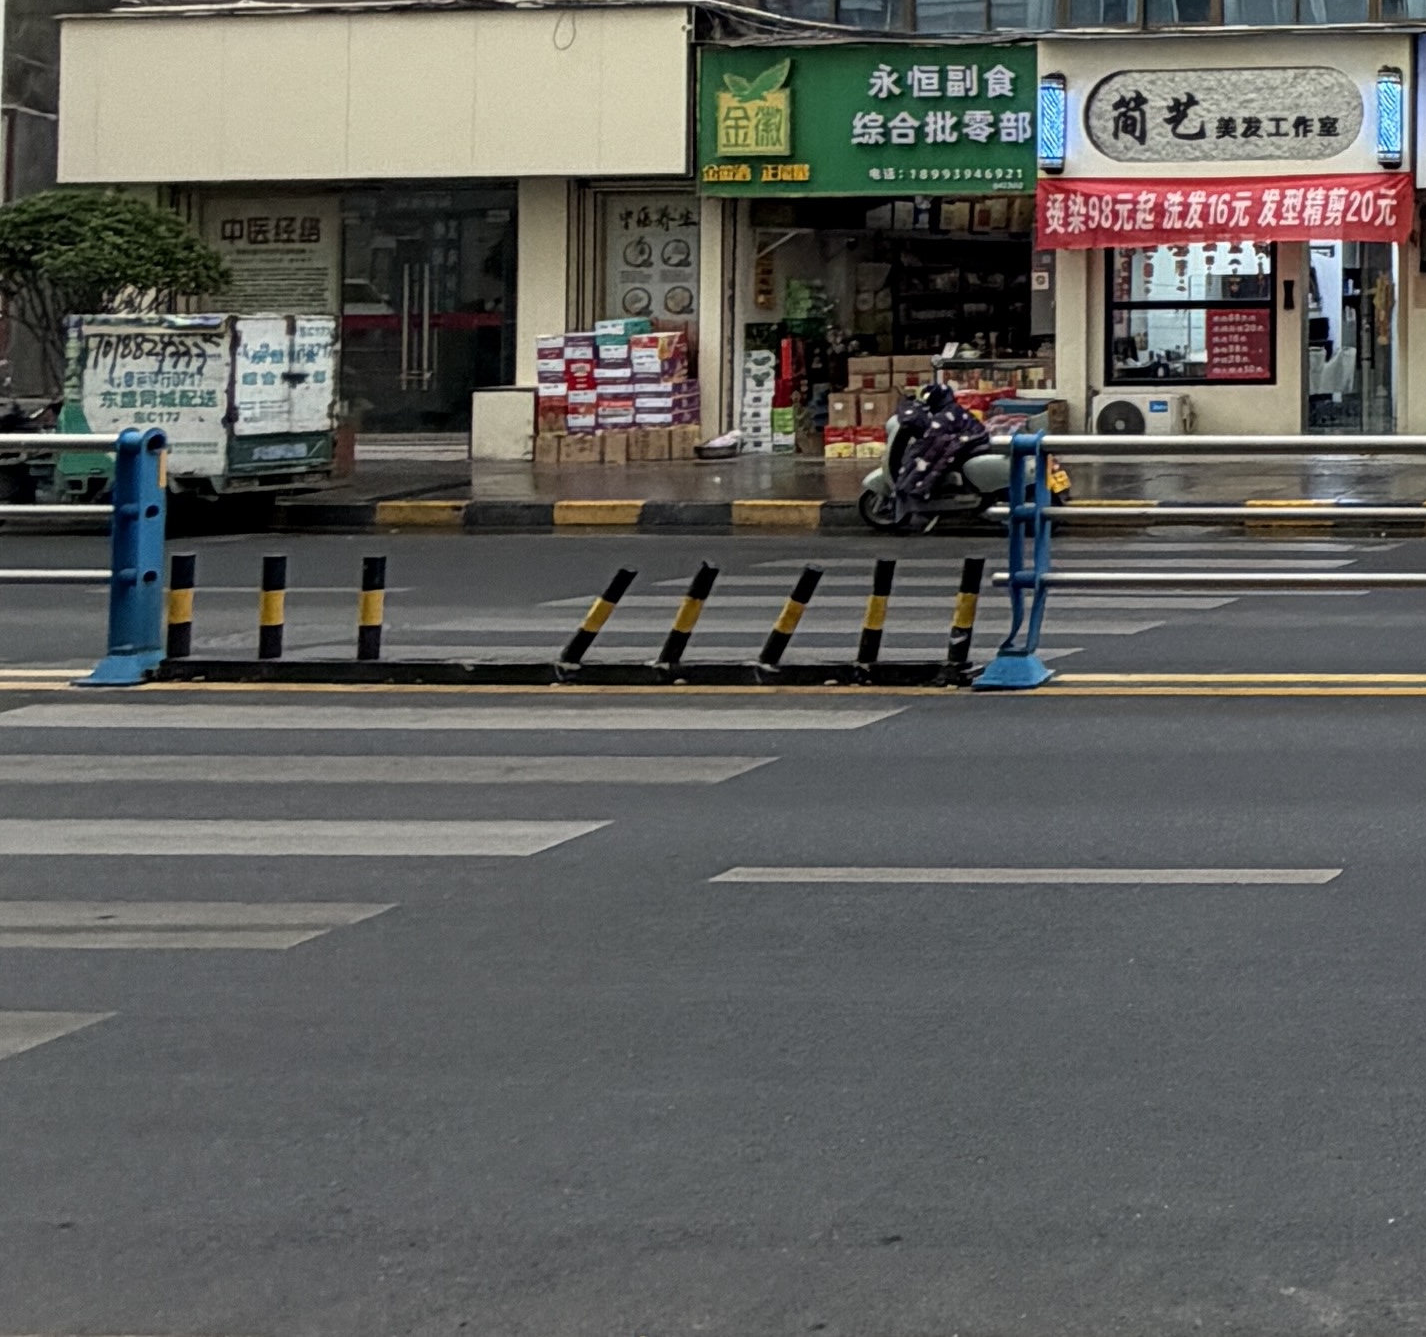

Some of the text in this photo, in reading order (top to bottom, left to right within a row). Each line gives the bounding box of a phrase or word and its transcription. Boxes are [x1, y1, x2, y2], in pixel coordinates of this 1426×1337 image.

[867, 63, 1016, 99] 永恒副食
[722, 105, 783, 148] 金徽
[851, 110, 1032, 146] 综合批零部
[1111, 89, 1341, 145] 简艺 美发工作室
[1162, 189, 1252, 230] 洗发16元
[1258, 187, 1397, 227] 发型精剪20元
